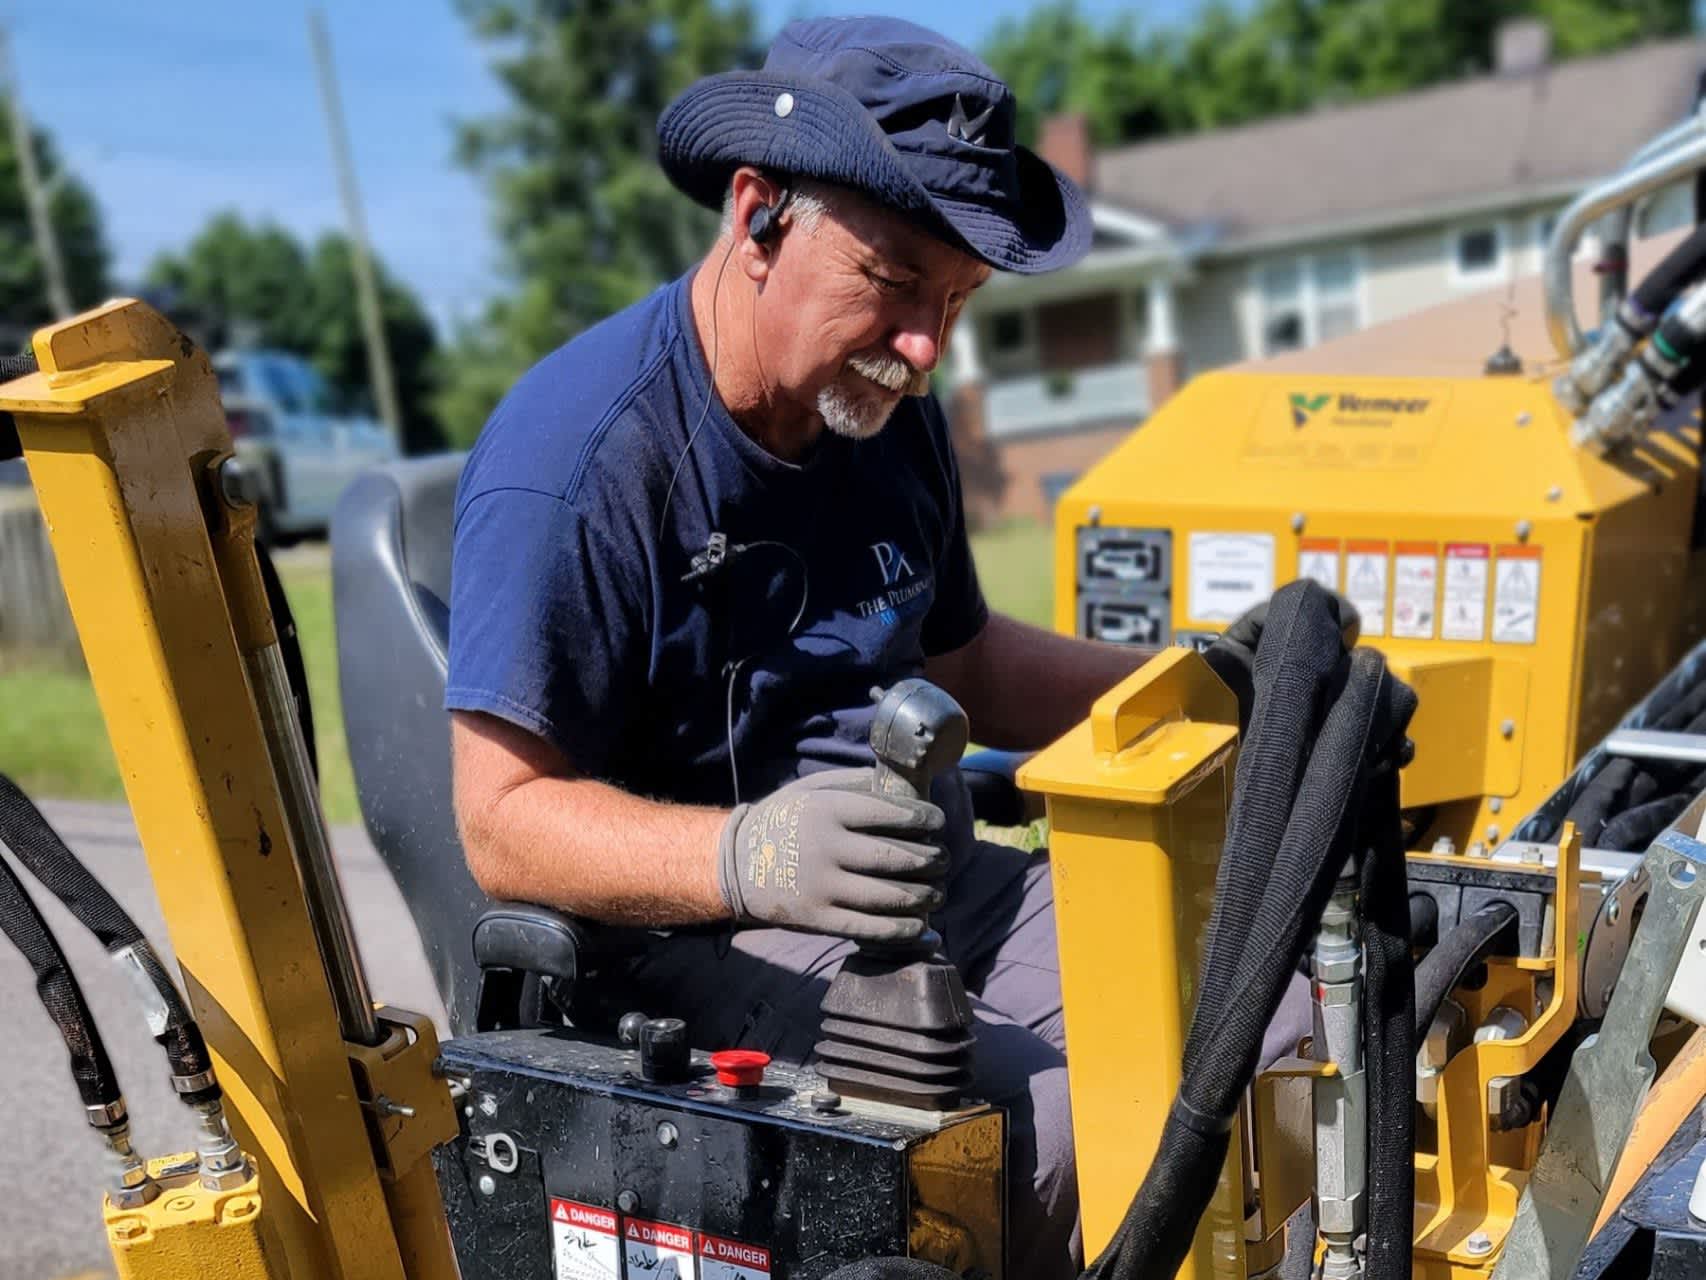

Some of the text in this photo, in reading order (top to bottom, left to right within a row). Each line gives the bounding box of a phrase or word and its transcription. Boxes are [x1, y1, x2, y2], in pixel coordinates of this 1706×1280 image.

[856, 597, 887, 617] THE
[570, 1208, 616, 1230] DANGER
[642, 1228, 689, 1249] DANGER
[718, 1243, 767, 1266] DANGER
